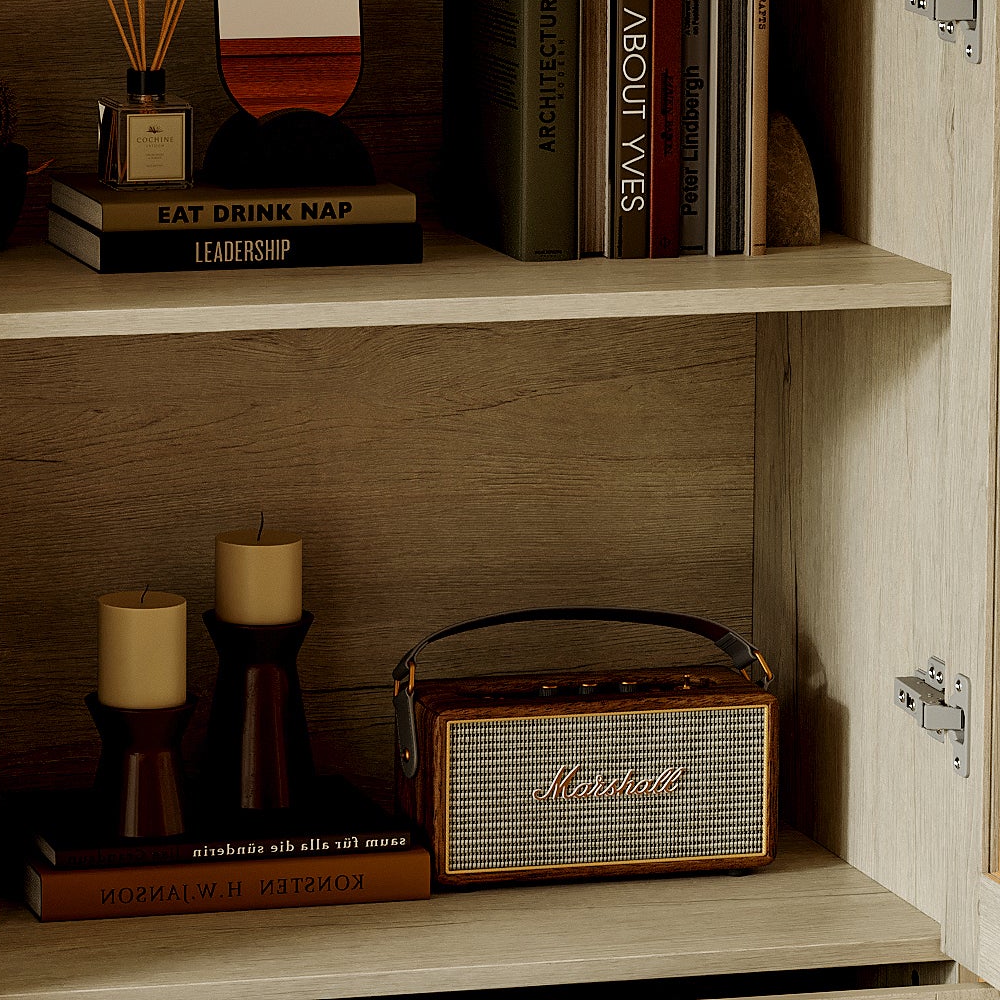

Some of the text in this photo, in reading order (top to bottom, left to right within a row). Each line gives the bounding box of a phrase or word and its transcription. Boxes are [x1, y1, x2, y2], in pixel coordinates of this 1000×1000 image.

[621, 7, 647, 119] ABOUT
[680, 65, 704, 216] Peter Lindbergh
[620, 133, 645, 212] YVES
[158, 201, 353, 225] EAT DRINK NAP
[195, 239, 290, 263] LEADERSHIP
[532, 763, 687, 801] Marshall
